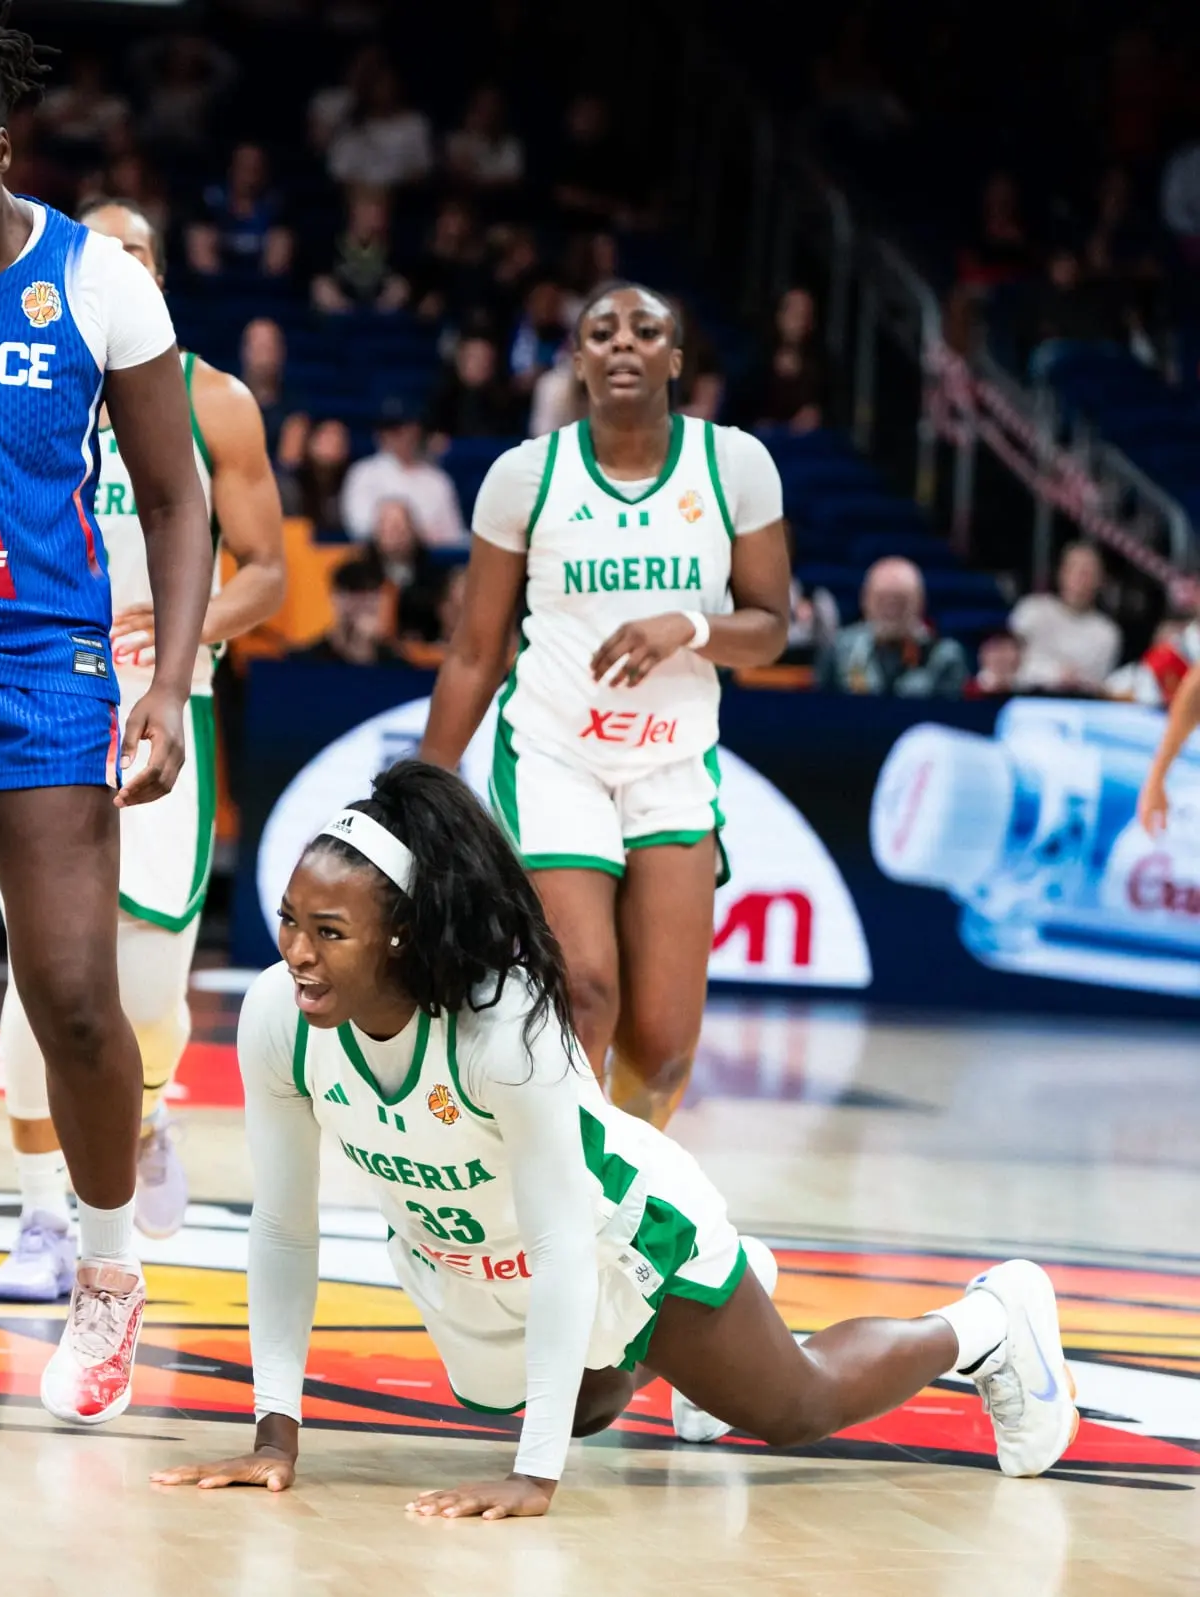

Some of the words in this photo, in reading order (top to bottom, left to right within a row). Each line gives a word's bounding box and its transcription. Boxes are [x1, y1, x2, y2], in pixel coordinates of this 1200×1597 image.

[563, 556, 702, 594] NIGERIA
[337, 1134, 497, 1191] NIGERIA
[405, 1200, 486, 1245] 33
